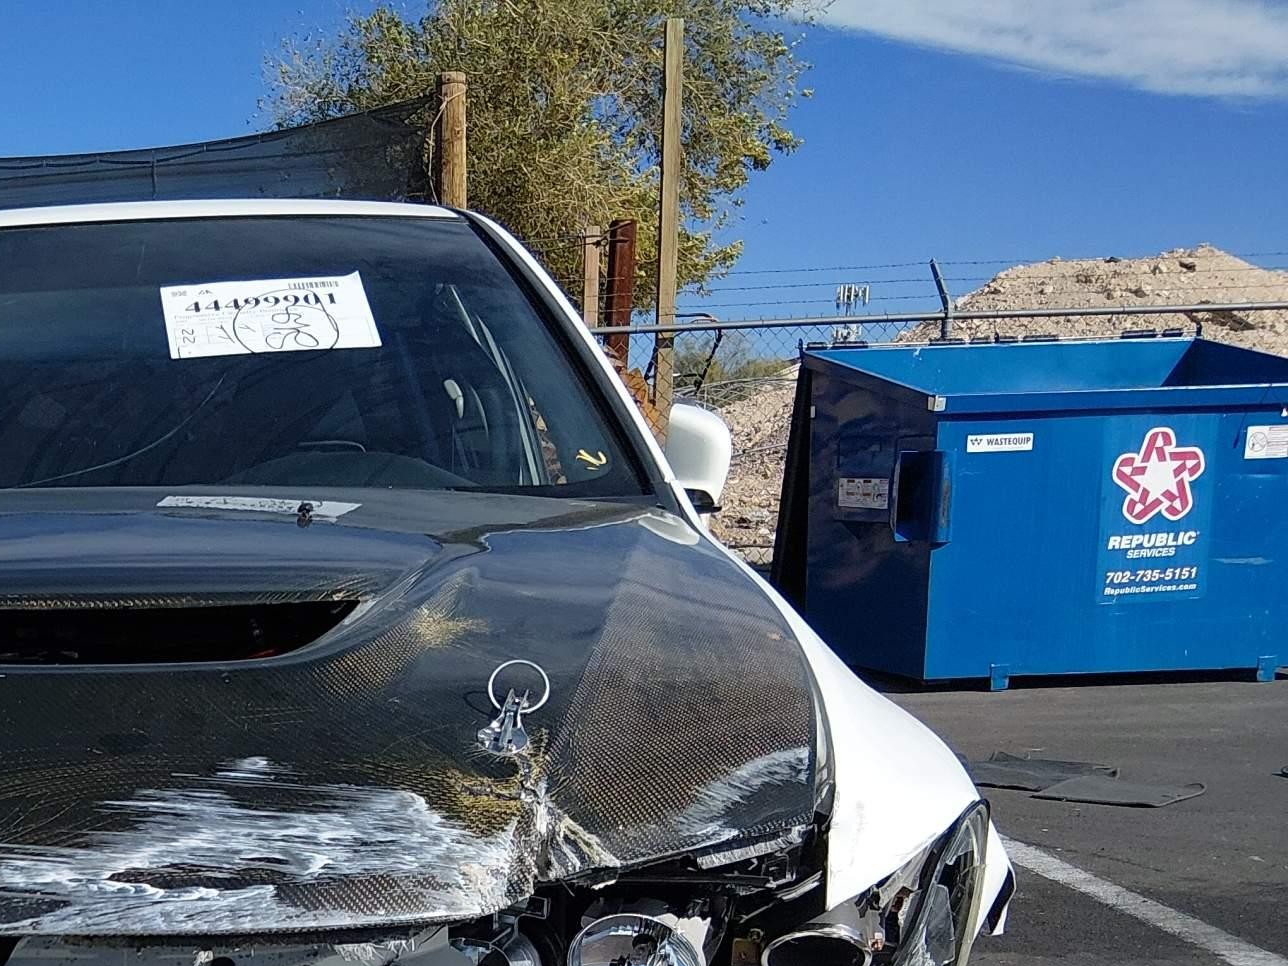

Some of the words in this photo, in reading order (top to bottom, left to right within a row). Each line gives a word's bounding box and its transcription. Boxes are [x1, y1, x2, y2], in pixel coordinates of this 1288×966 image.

[185, 292, 337, 313] 44499901
[986, 437, 1031, 446] WASTEQUIP
[1107, 531, 1197, 550] REPUBLIC
[1126, 547, 1176, 559] SERVICES
[1106, 566, 1197, 584] 702-735-5151
[1103, 583, 1197, 596] RepublicServices.com
